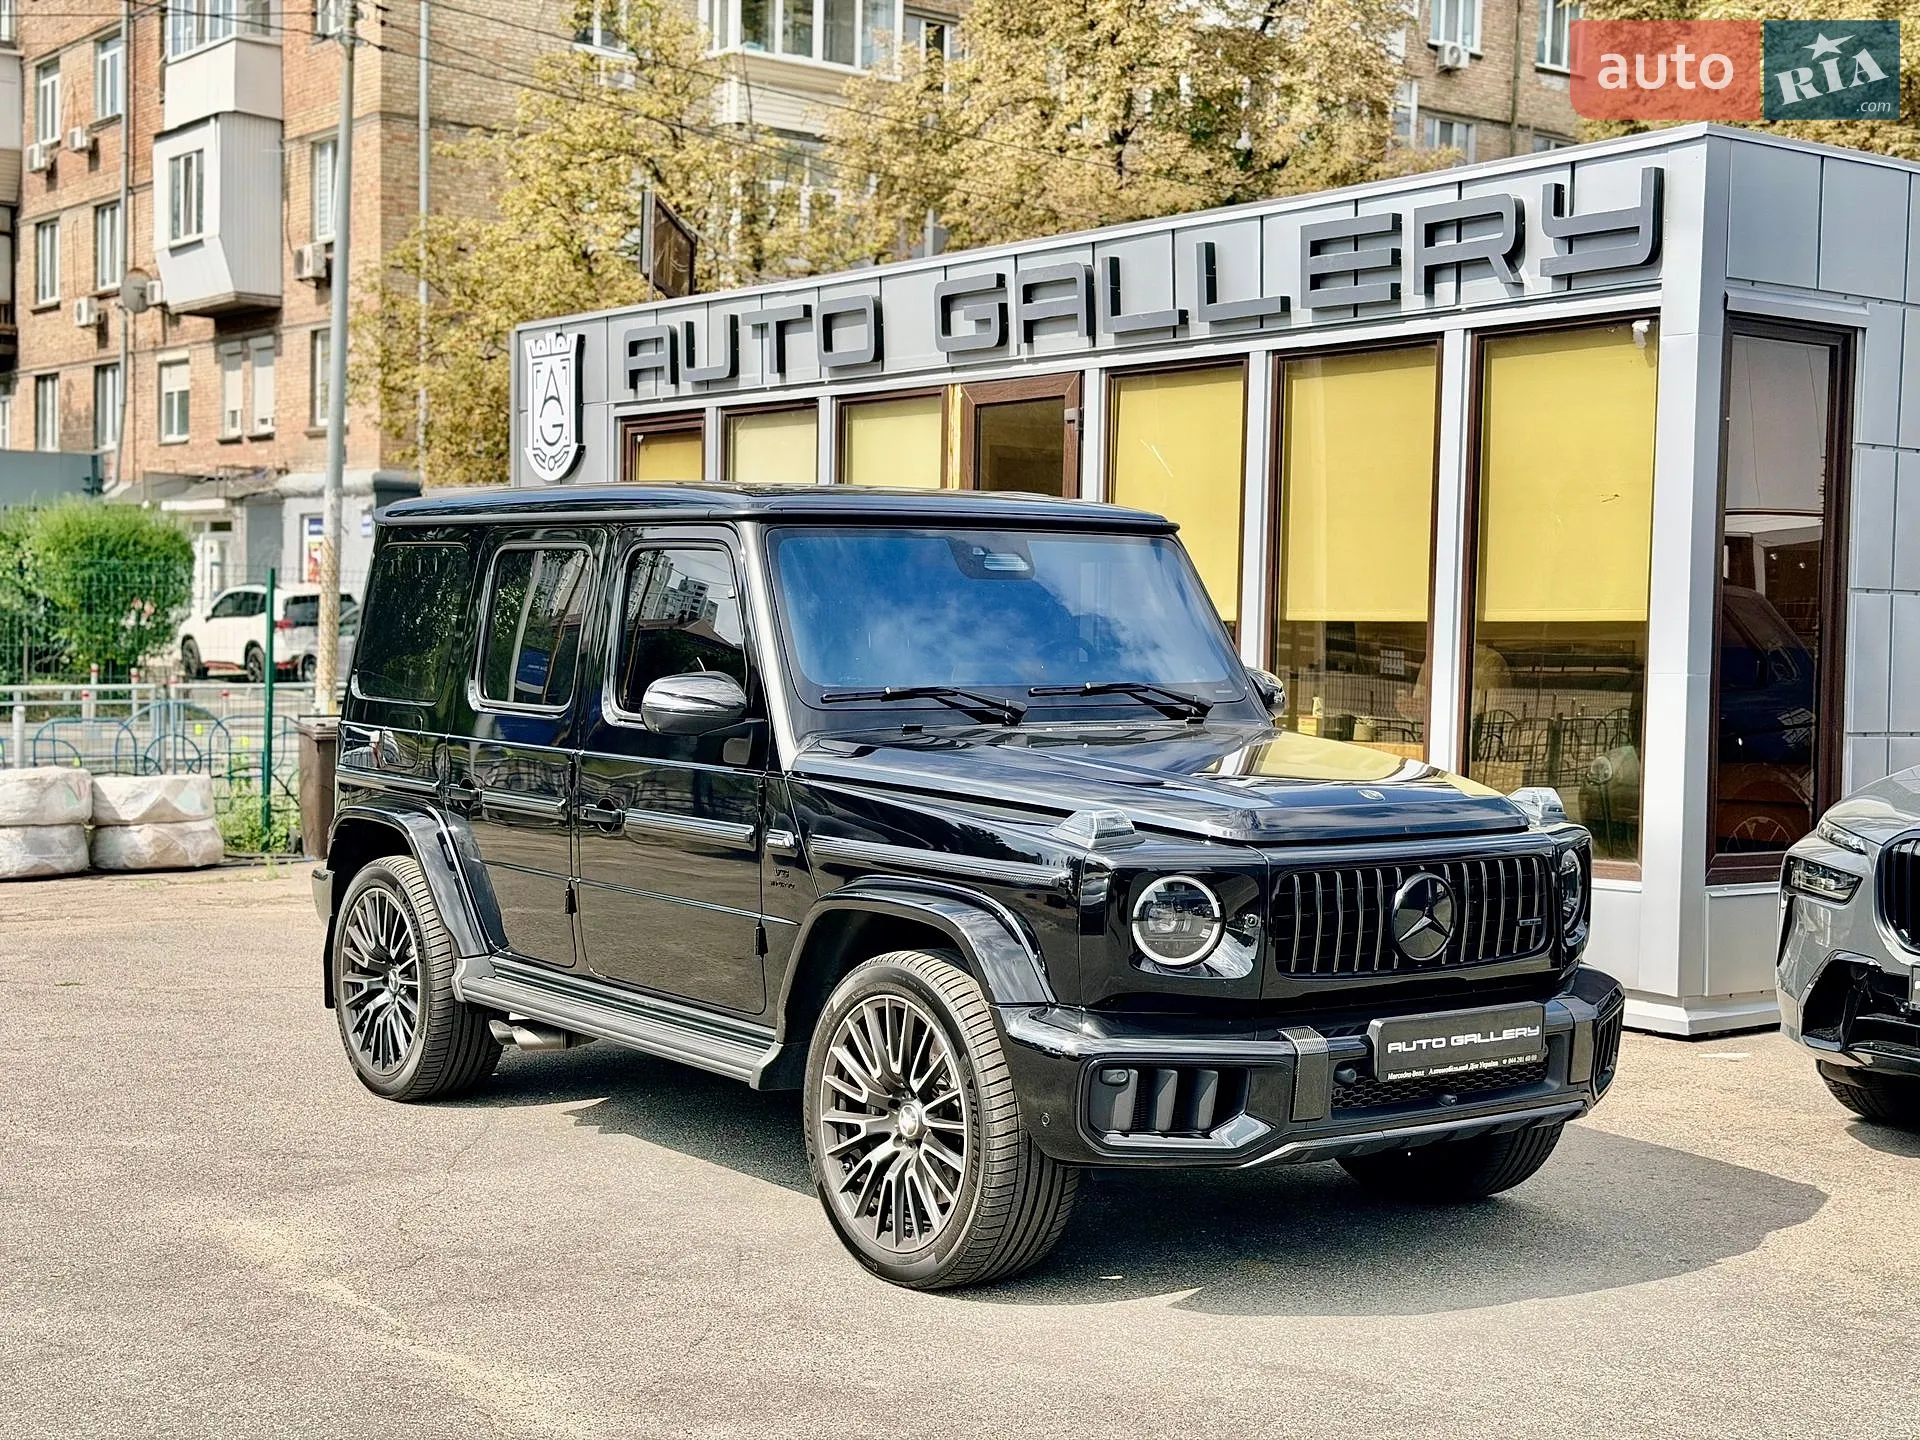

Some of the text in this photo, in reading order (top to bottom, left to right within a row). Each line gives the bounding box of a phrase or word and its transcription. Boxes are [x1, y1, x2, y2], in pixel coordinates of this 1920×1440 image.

[623, 167, 1665, 391] AUTO GALLERY
[1387, 1025, 1540, 1054] AUTO GALLERY
